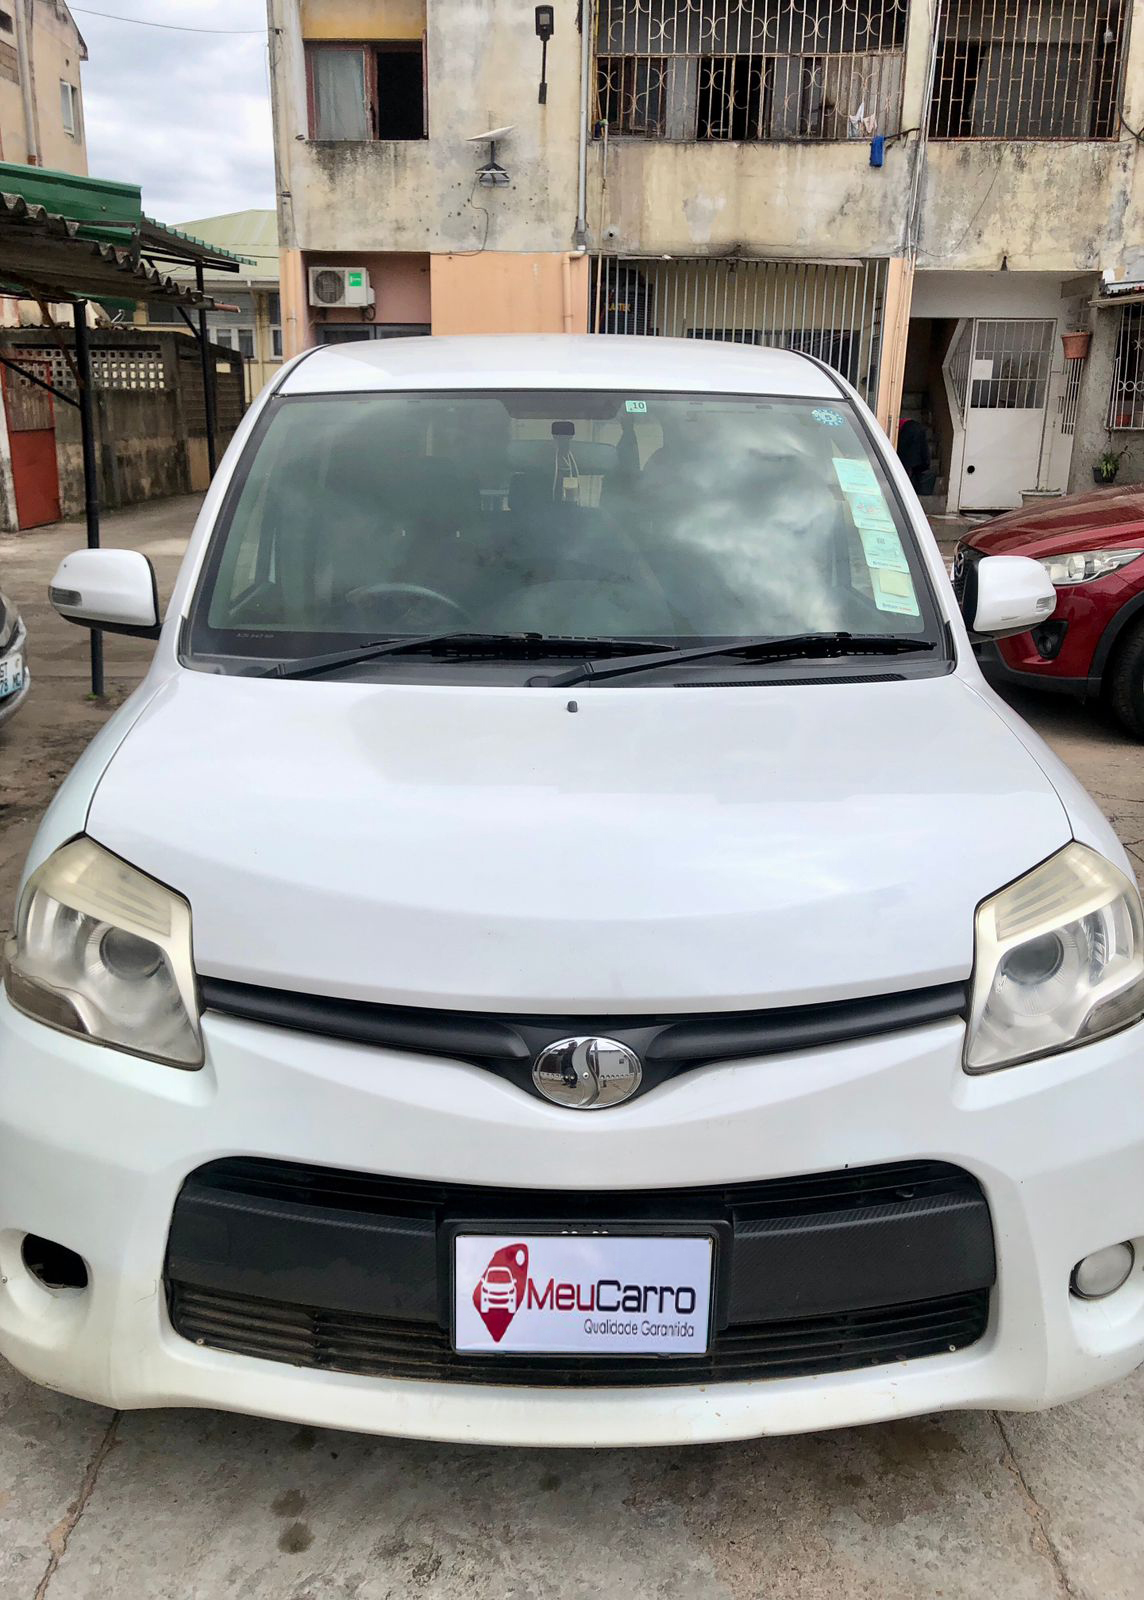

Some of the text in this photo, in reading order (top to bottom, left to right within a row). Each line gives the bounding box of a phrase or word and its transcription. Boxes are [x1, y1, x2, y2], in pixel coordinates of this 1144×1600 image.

[527, 1278, 696, 1314] MeuCarro
[584, 1318, 694, 1337] Qualidade Garantida
